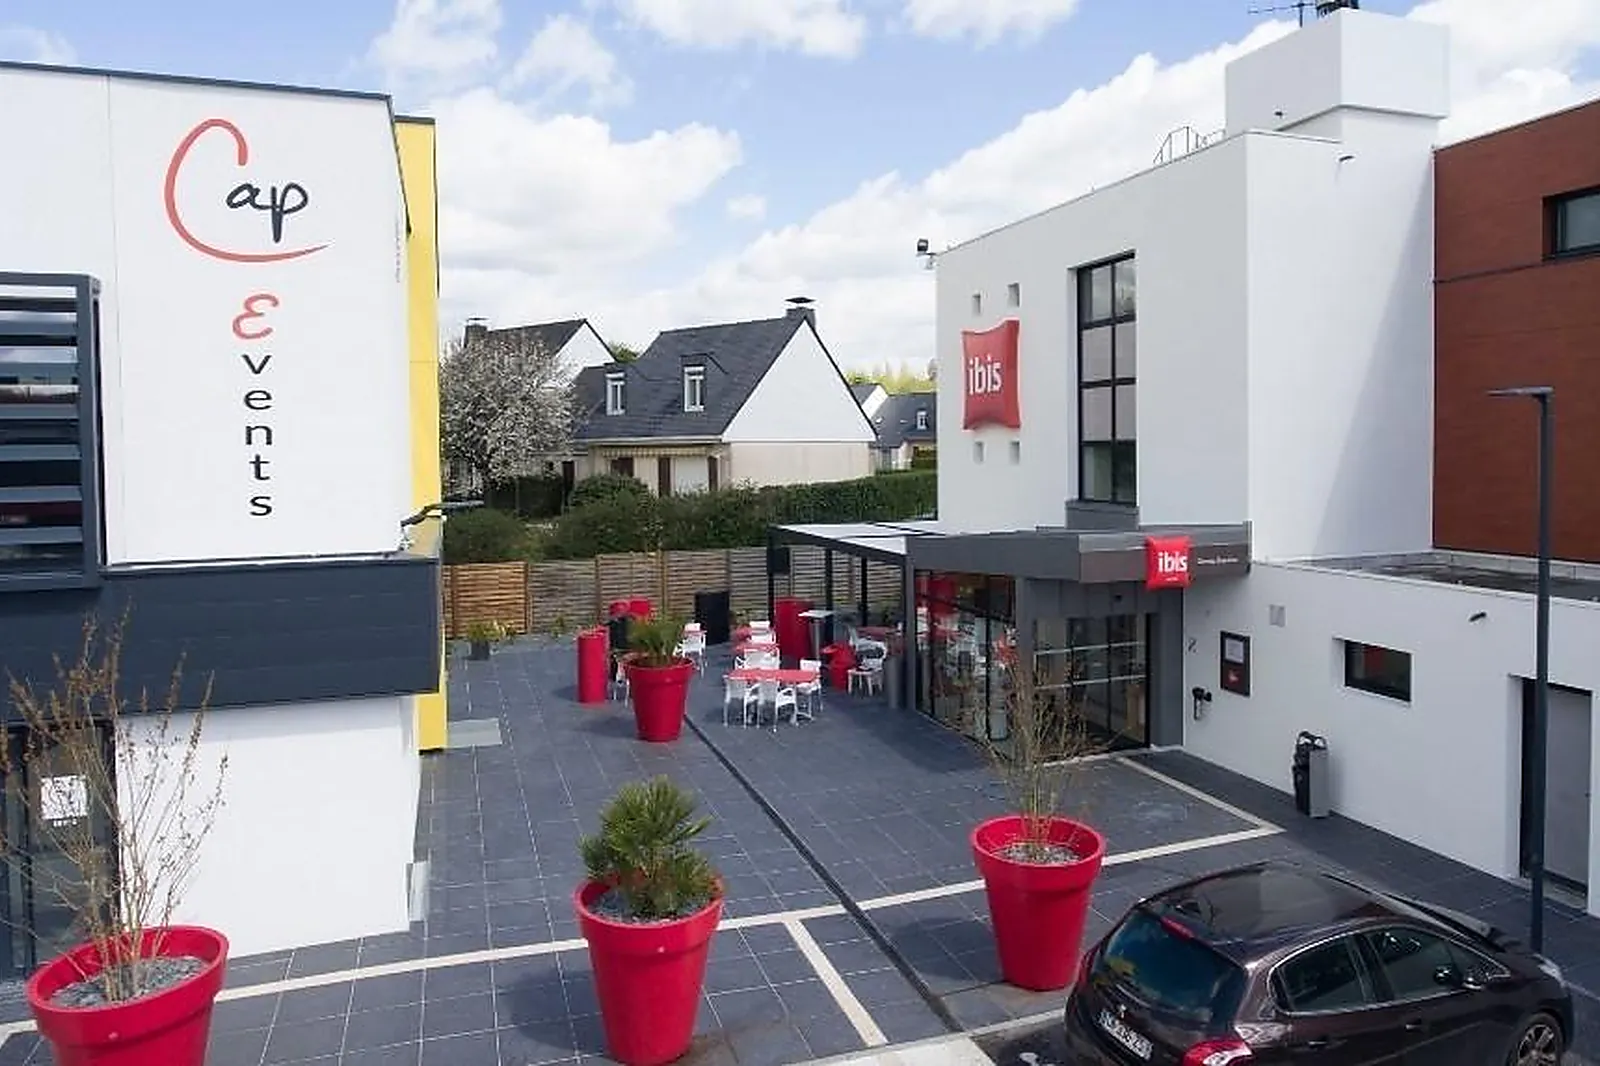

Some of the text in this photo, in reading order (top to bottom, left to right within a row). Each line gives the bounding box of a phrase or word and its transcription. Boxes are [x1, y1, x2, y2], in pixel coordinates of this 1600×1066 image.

[164, 118, 330, 263] Cap
[231, 293, 279, 517] Events
[969, 354, 1002, 396] ibis
[1157, 550, 1189, 573] ibis
